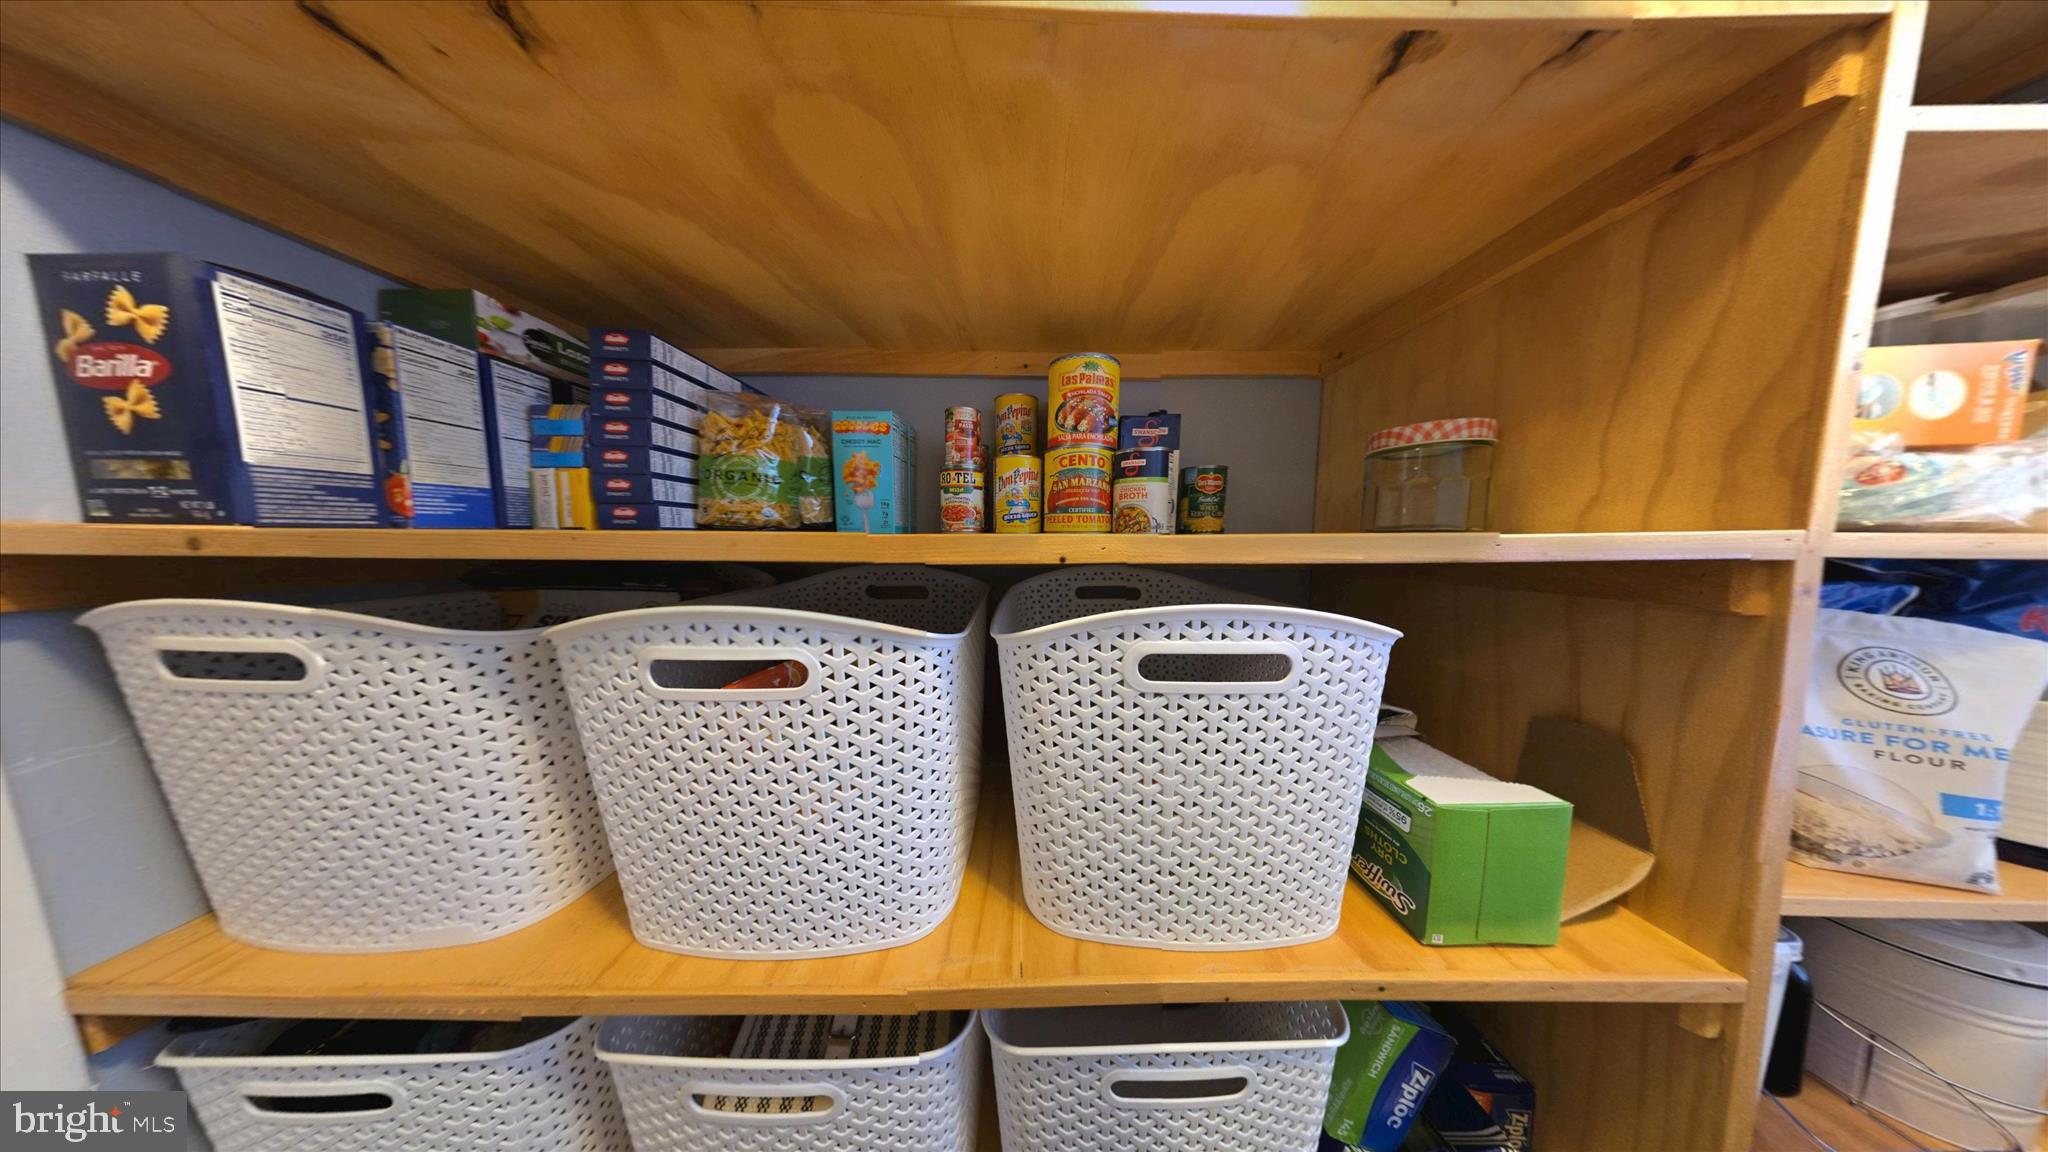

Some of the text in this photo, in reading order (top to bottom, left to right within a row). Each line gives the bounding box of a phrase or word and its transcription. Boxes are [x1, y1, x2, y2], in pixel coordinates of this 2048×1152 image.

[1061, 372, 1114, 388] Las Palmas
[1058, 454, 1106, 468] CENTO
[1052, 479, 1069, 492] SAN
[1119, 492, 1148, 500] BROTH
[1846, 651, 1875, 673] KING
[1841, 717, 1994, 742] GLUTEN-FREE
[1872, 749, 1967, 771] FLOUR
[1885, 735, 1951, 754] FOR
[1963, 745, 2012, 762] ME
[1364, 824, 1408, 865] CLOTHS
[1369, 842, 1393, 866] DRY
[1352, 853, 1417, 917] Swiffer
[1367, 1023, 1401, 1079] SANDWICH
[1386, 1069, 1432, 1131] Ziploc
[1504, 1112, 1529, 1152] Ziplo
